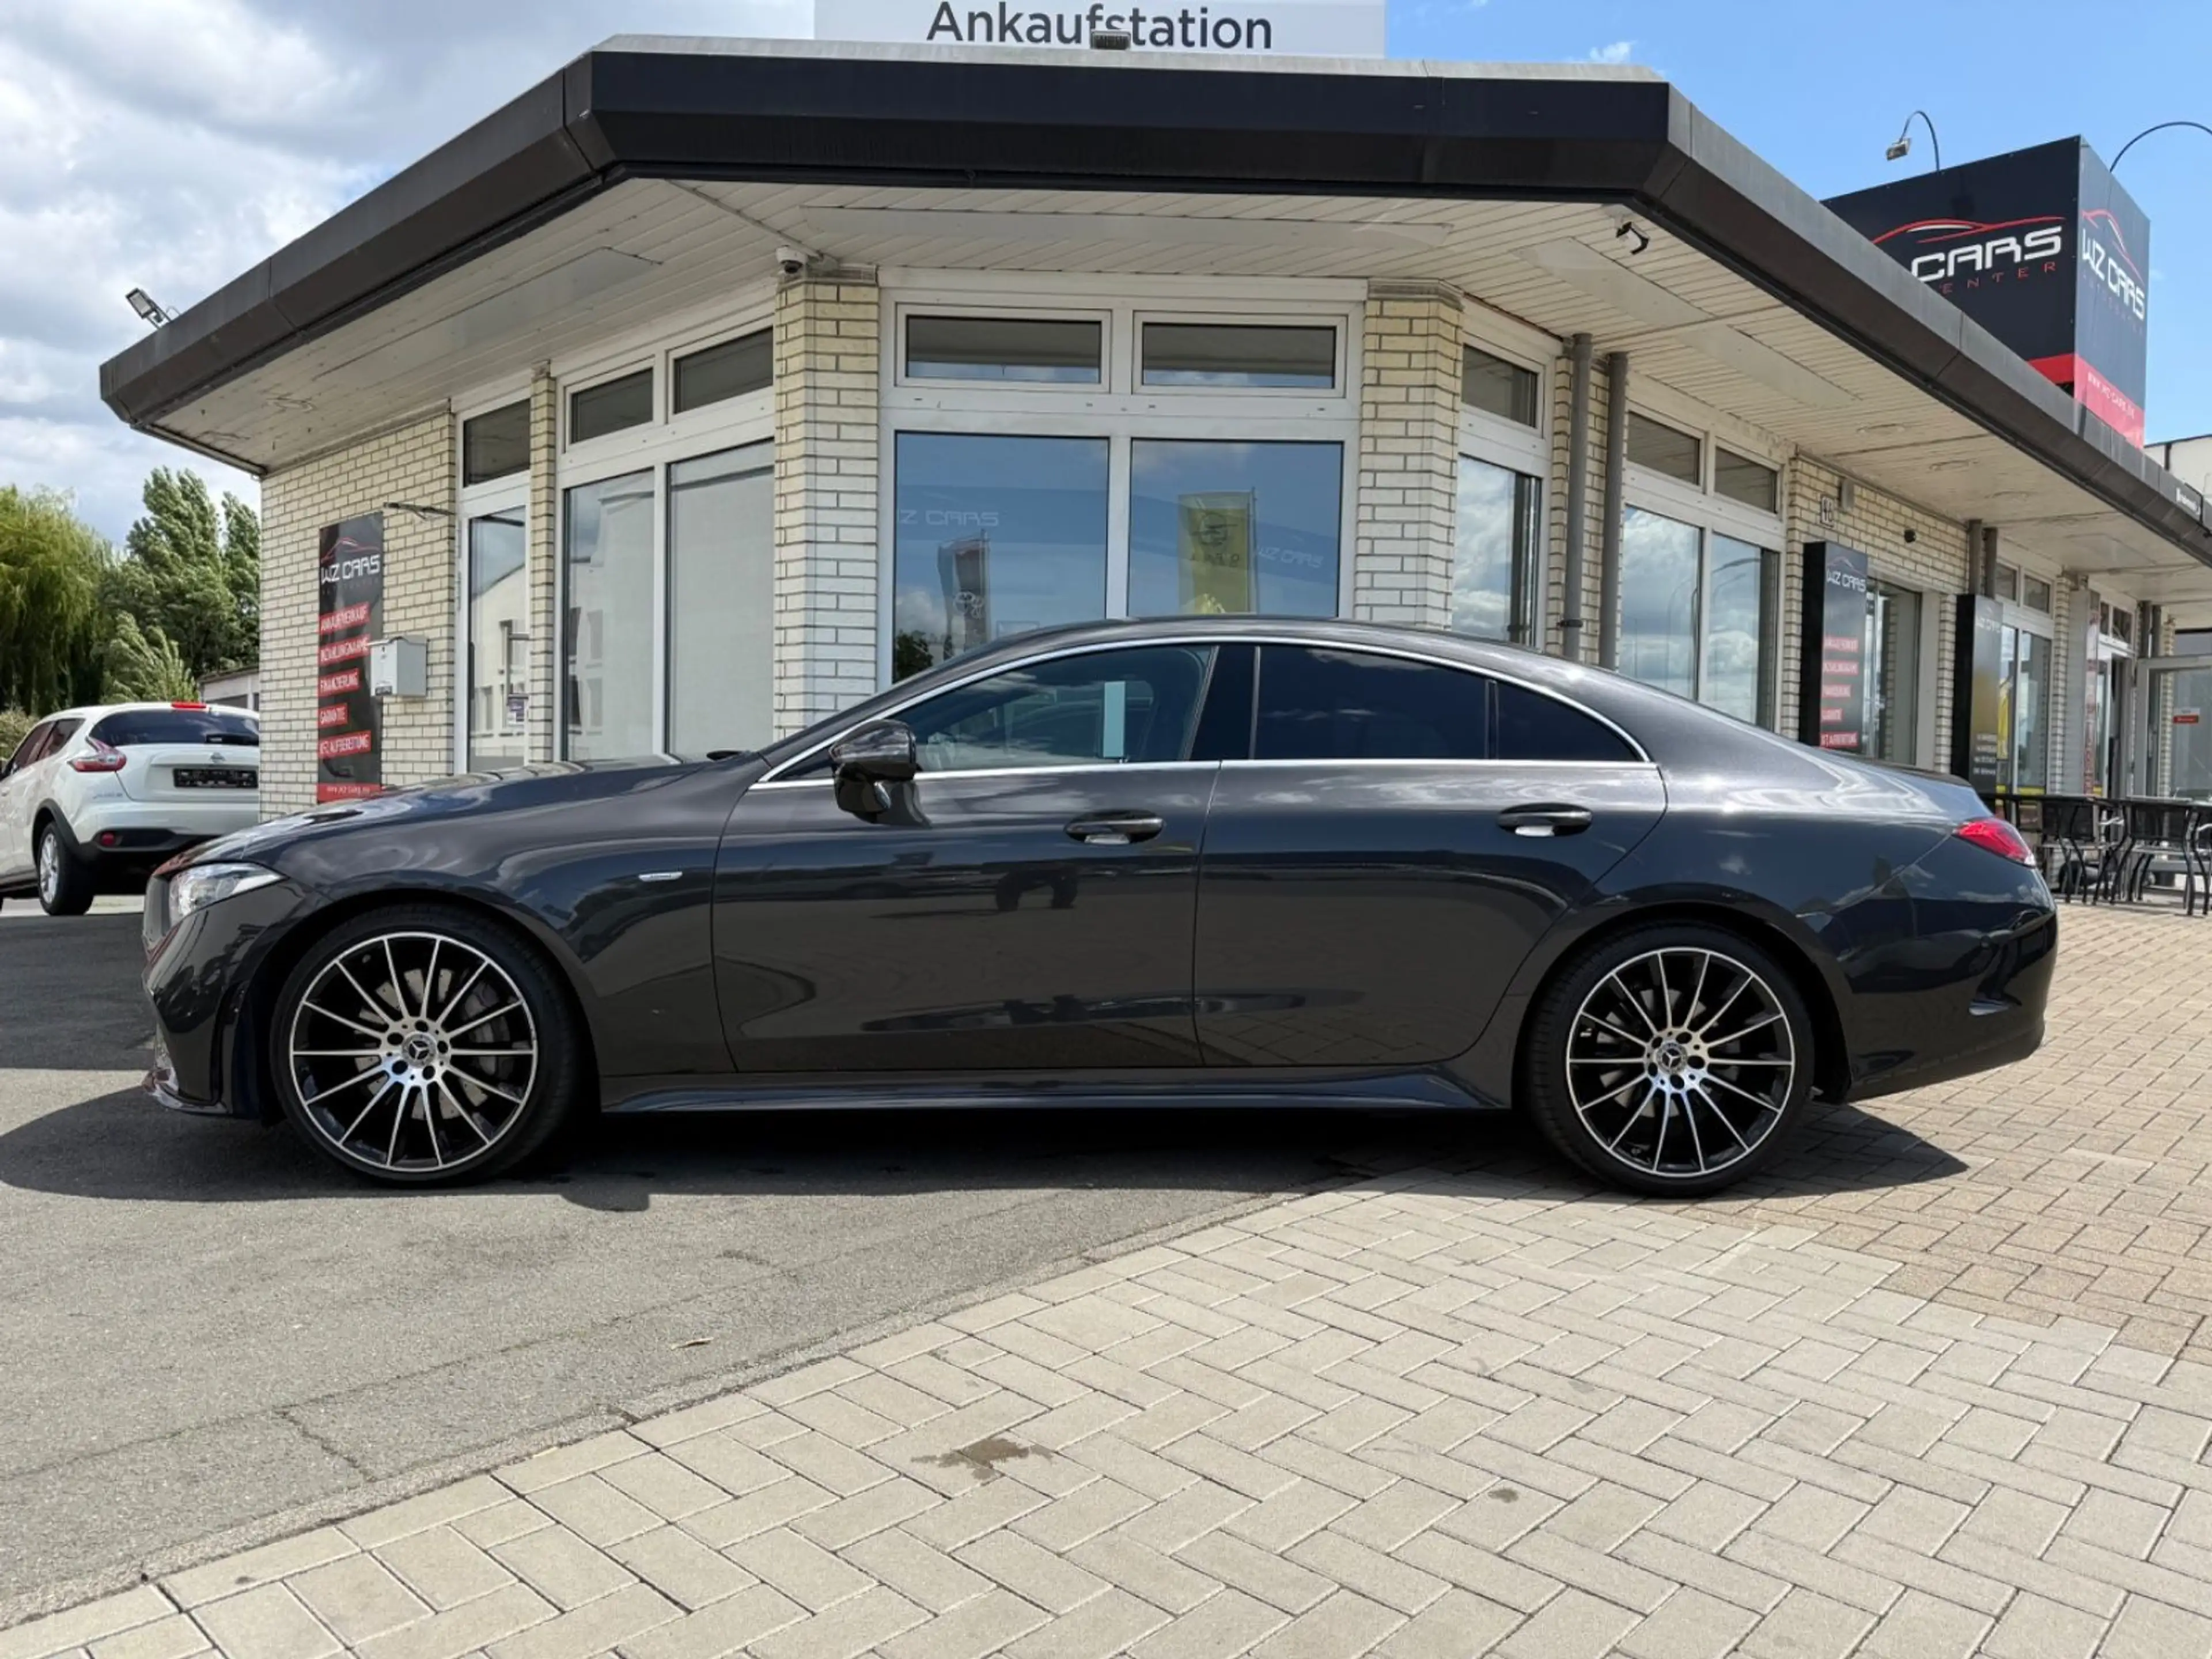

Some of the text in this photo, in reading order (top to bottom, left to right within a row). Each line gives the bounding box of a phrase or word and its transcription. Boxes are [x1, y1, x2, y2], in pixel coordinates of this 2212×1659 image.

[1911, 225, 2062, 282] CARS
[2082, 228, 2106, 281] WZ
[2108, 256, 2145, 321] CARS
[321, 554, 381, 584] WZ CARS
[1842, 574, 1866, 593] CARS
